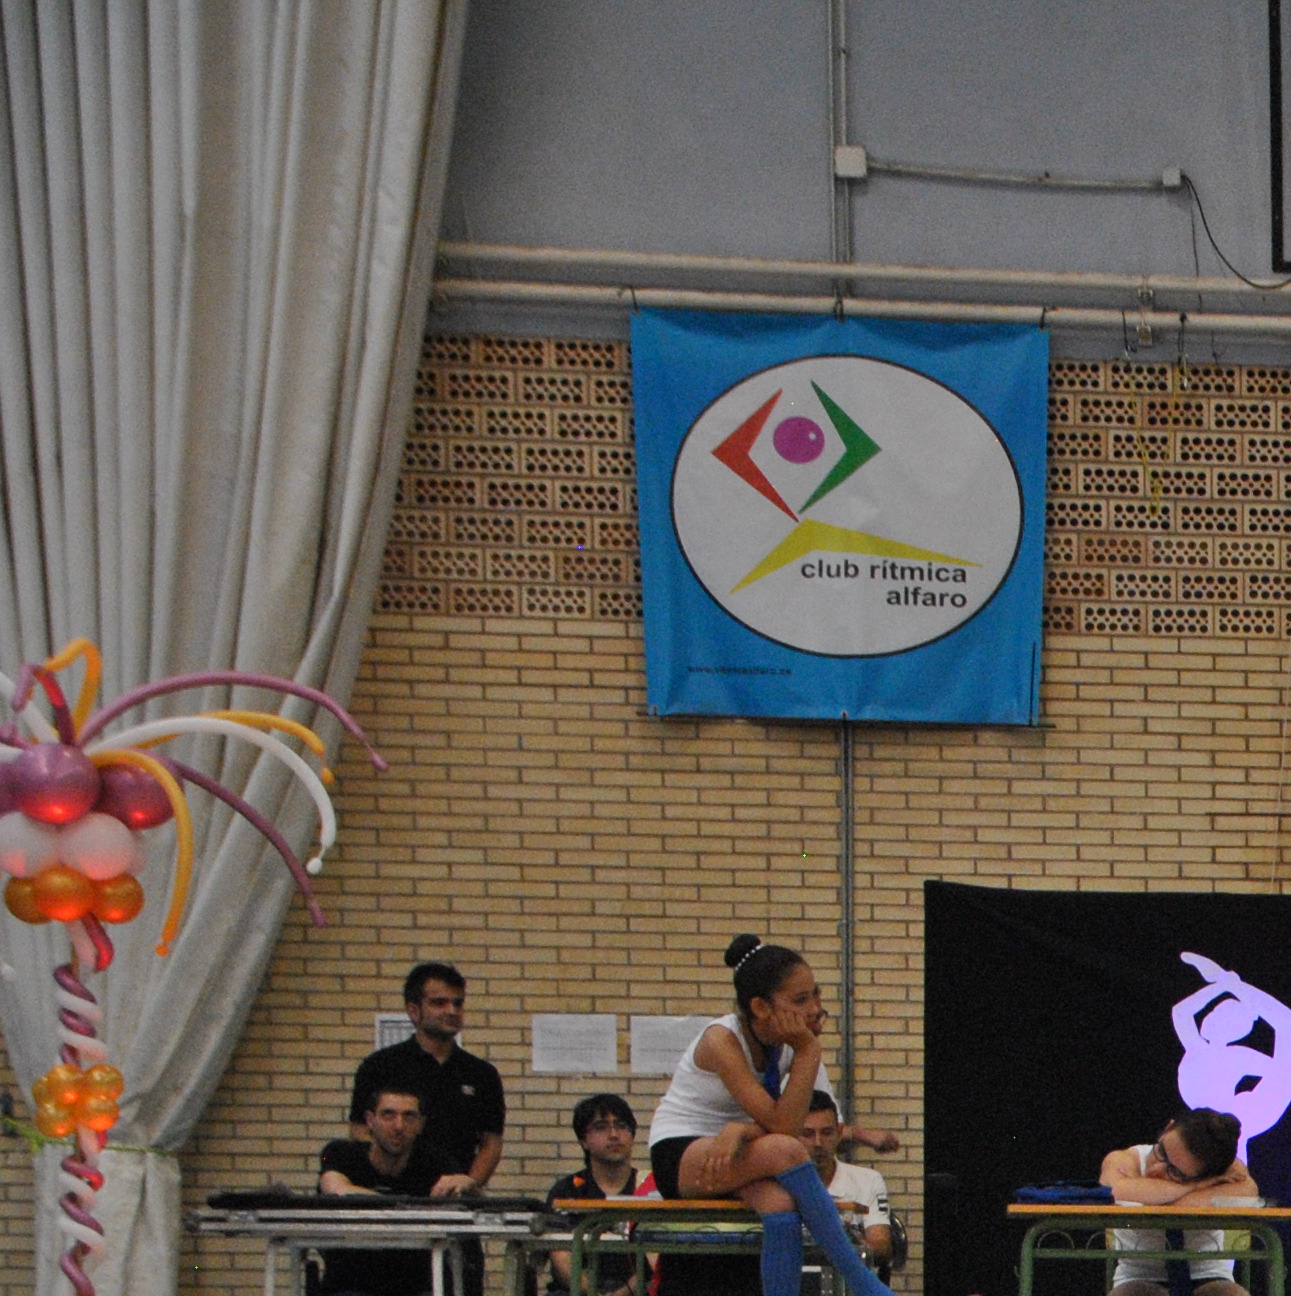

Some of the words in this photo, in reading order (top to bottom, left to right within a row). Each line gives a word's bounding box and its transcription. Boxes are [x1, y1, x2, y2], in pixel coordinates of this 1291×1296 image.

[800, 558, 860, 581] club
[869, 558, 968, 583] rítmica
[886, 586, 968, 609] alfaro
